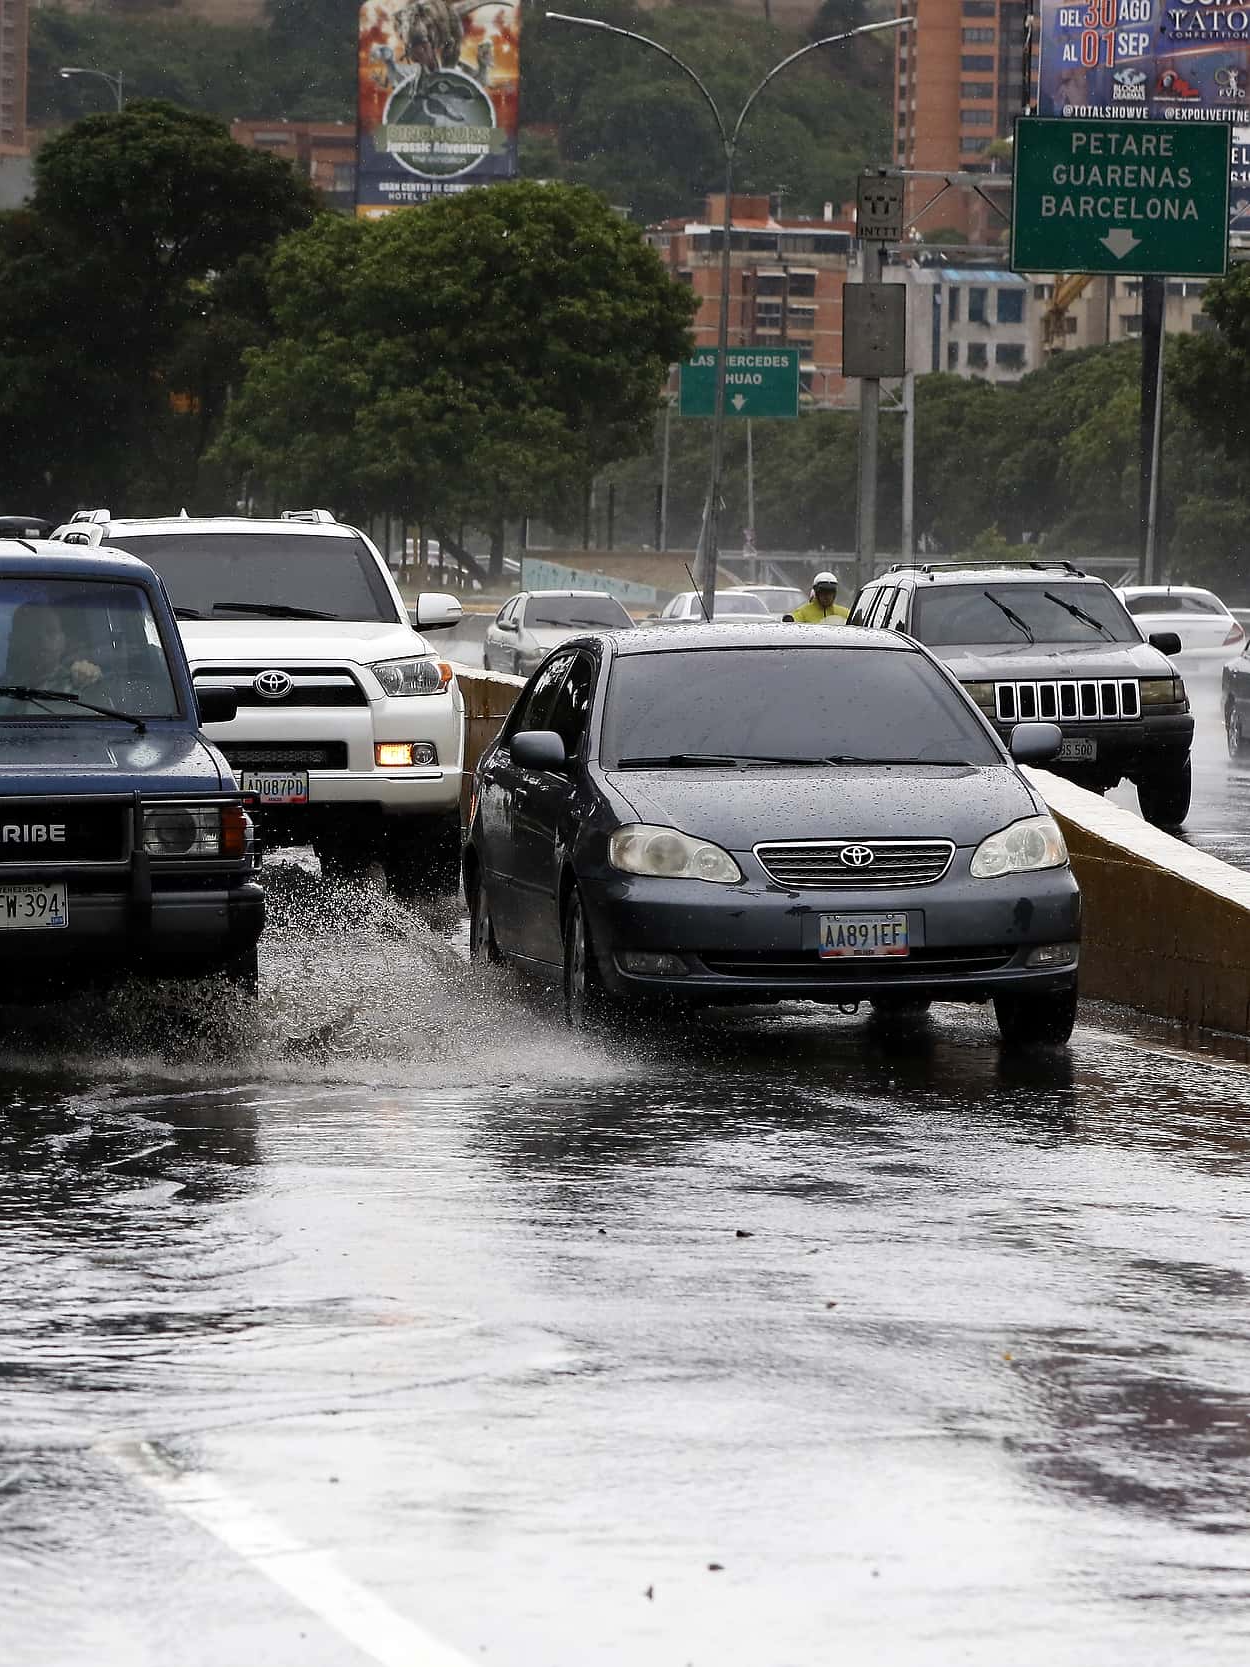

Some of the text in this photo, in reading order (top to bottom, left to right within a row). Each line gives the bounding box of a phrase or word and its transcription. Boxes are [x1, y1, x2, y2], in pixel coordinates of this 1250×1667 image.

[1060, 0, 1150, 28] DEL 30 AGO
[1168, 31, 1249, 39] COMPETITION
[1062, 29, 1149, 68] AL 01 SEP
[1063, 104, 1149, 119] @TOTALSHOWVE
[1071, 132, 1174, 157] PETARE
[1052, 164, 1192, 188] GUARENAS
[388, 192, 417, 201] HOTEL
[1041, 195, 1199, 221] BARCELONA
[690, 355, 789, 368] LAS ERCEDES
[724, 373, 762, 385] HUAO
